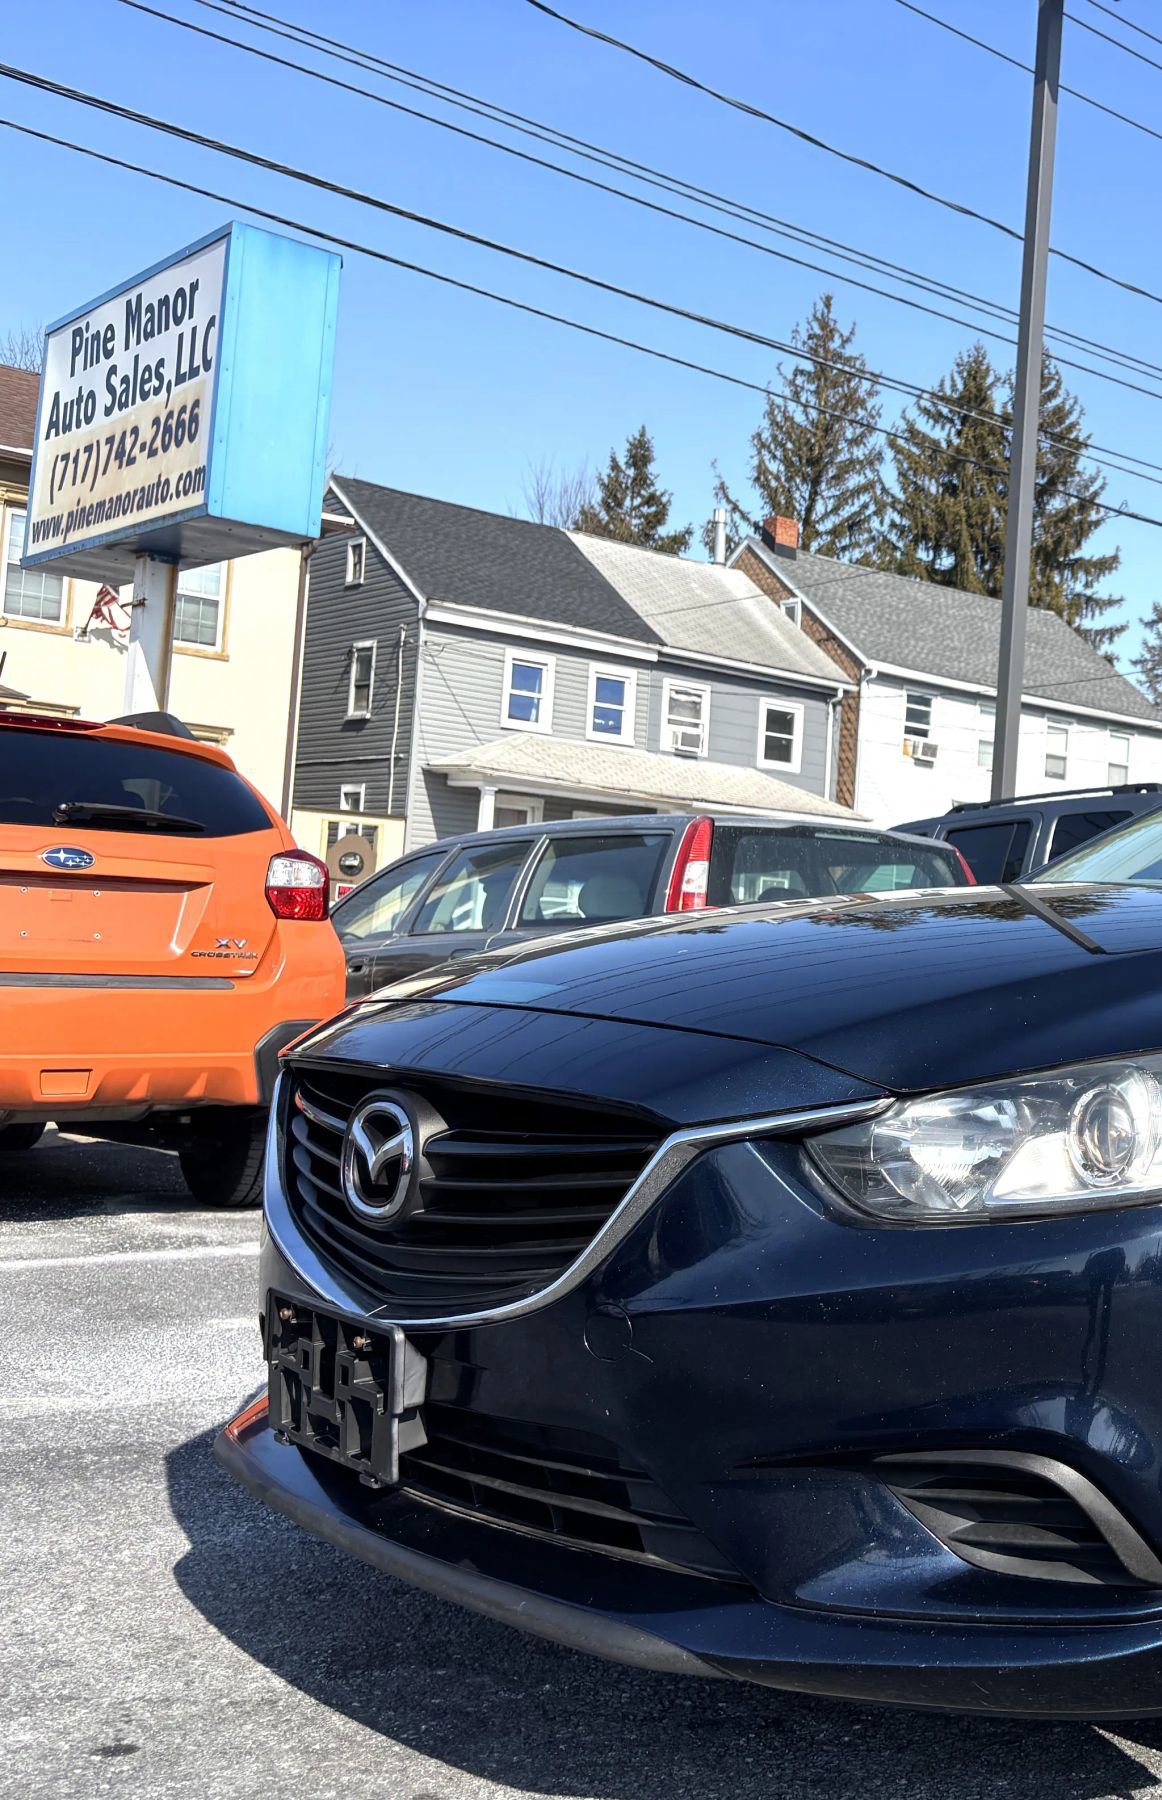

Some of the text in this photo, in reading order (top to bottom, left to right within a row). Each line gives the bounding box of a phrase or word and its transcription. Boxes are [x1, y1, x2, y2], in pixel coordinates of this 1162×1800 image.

[70, 278, 200, 378] Pine Manor
[45, 385, 97, 440] Auto
[50, 398, 201, 504] (717)742-2666
[32, 464, 207, 544] www.pinemanorauto.com
[216, 938, 248, 950] XV
